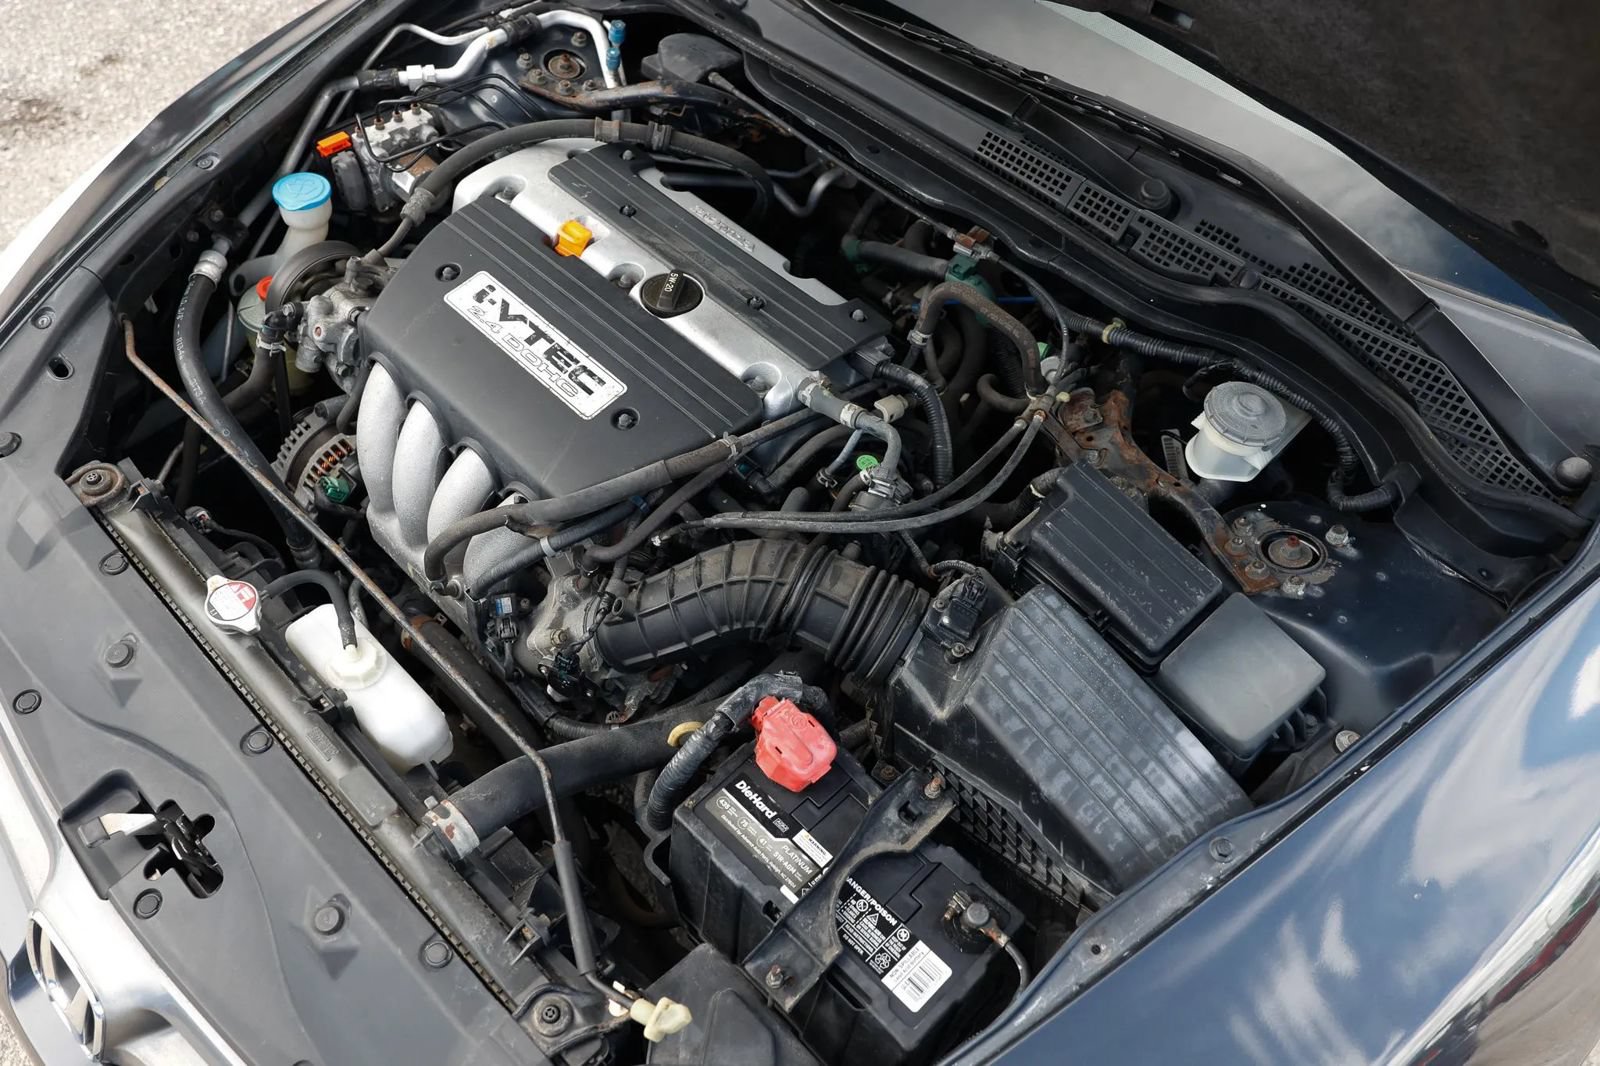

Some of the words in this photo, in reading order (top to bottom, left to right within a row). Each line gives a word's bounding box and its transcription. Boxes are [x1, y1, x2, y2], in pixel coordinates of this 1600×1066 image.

[664, 272, 679, 293] 5W-20
[473, 284, 607, 396] i-VTEC
[467, 306, 503, 334] 2.4
[502, 333, 579, 398] DOHC
[718, 798, 730, 810] 435
[735, 780, 777, 819] DieHard
[739, 818, 748, 827] 75
[740, 833, 754, 847] Advance
[758, 836, 767, 846] 41
[772, 850, 796, 874] 51R-AGM
[781, 844, 813, 875] PLATINUM
[846, 877, 898, 927] ANGER/POISON
[847, 938, 855, 946] NOT
